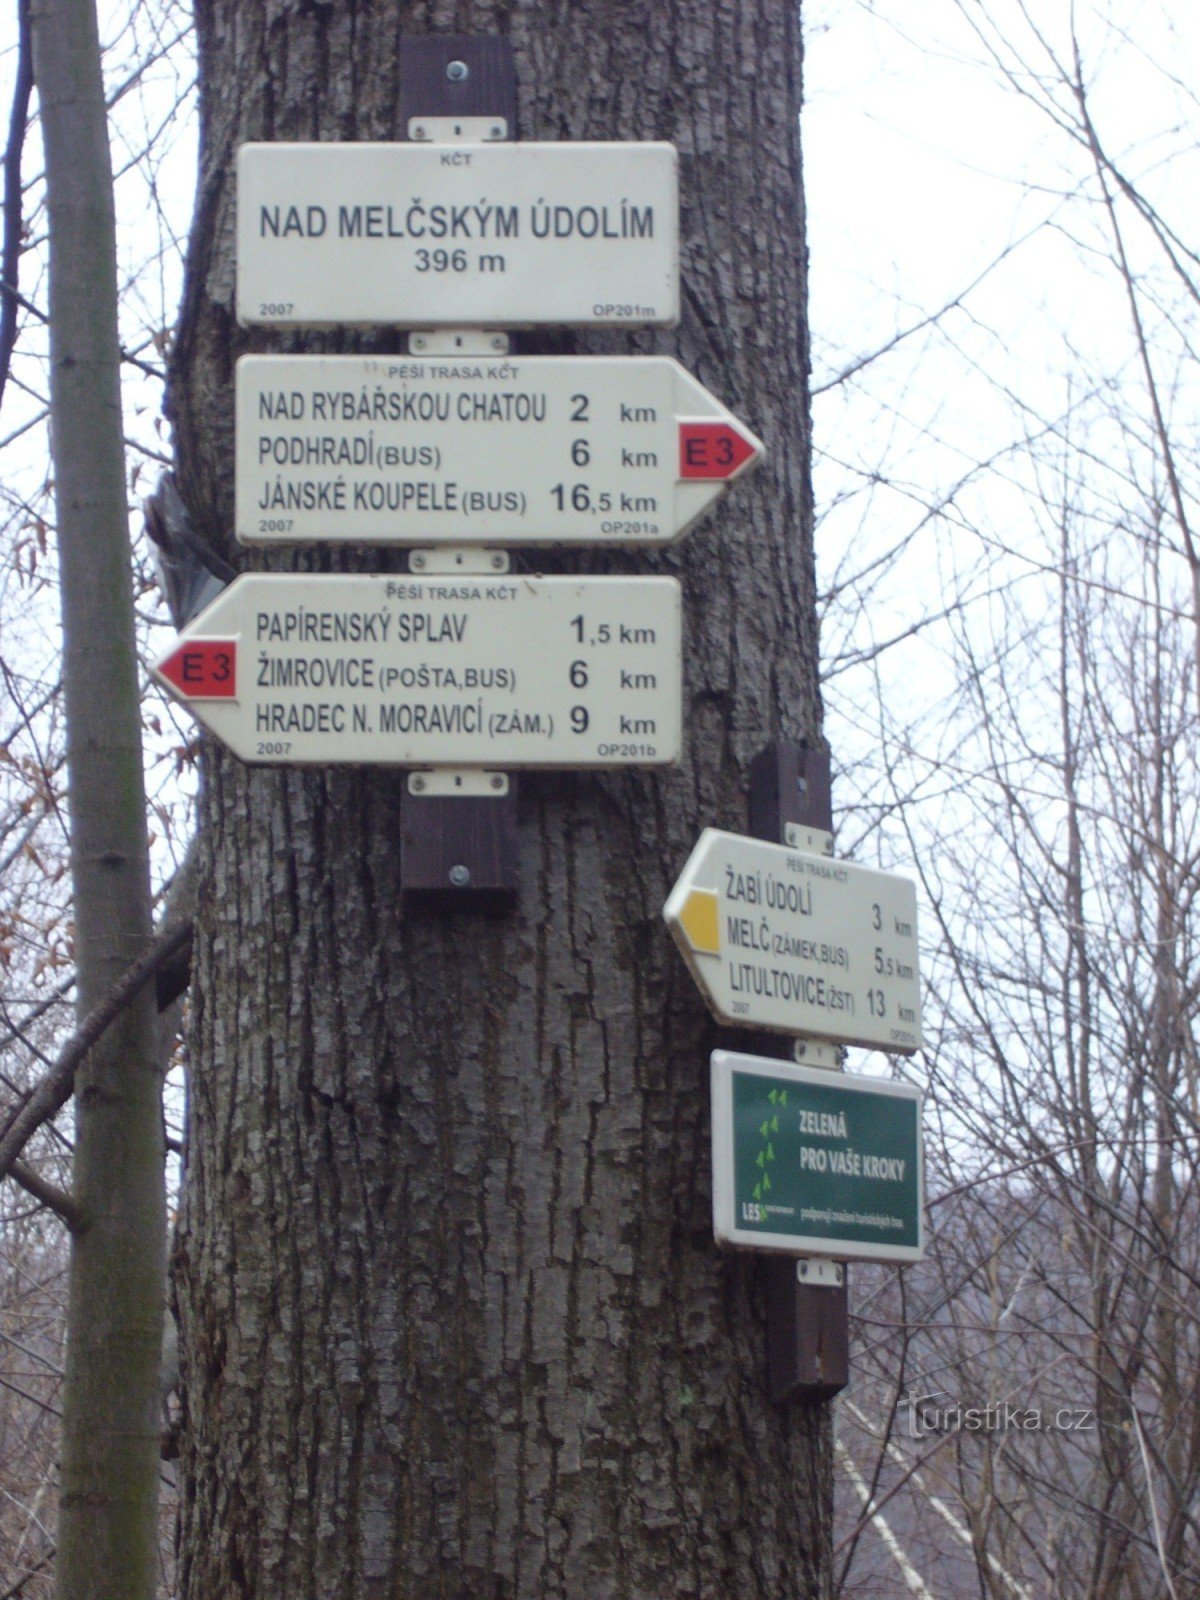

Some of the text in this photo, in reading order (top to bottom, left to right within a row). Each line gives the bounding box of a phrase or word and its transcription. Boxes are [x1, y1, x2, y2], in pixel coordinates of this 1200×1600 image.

[440, 152, 472, 168] KČT
[259, 197, 654, 238] NAD MELČSKÝM ÚDOLÍM
[415, 249, 505, 273] 396 m
[260, 303, 294, 316] 2007
[593, 304, 655, 318] OP201m
[429, 366, 482, 379] TRASA
[487, 362, 519, 380] KČT
[259, 386, 657, 422] NAD RYBÁŘSKOU CHATOU 2 km
[570, 438, 590, 466] 6
[621, 448, 657, 468] km
[258, 475, 346, 511] JÁNSKÉ
[620, 493, 656, 512] km
[259, 519, 293, 532] 2007
[427, 587, 482, 600] TRASA
[486, 585, 518, 600] KČT
[256, 606, 656, 646] PAPÍRENSKÝ SPLAV 1,5 km
[569, 661, 589, 689] 6
[620, 670, 657, 689] km
[256, 704, 345, 733] HRADEC
[353, 703, 372, 733] N.
[380, 697, 482, 733] MORAVICÍ
[570, 706, 589, 734] 9
[620, 716, 657, 735] km
[256, 743, 292, 755] 2007
[597, 744, 656, 757] OP201b
[725, 864, 912, 937] ŽABÍ ÚDOLÍ 3 km
[896, 959, 914, 980] km
[866, 988, 885, 1017] 13
[898, 1003, 915, 1023] km
[799, 1110, 847, 1138] ZELENÁ
[800, 1147, 906, 1182] PRO VAŠE KROKY
